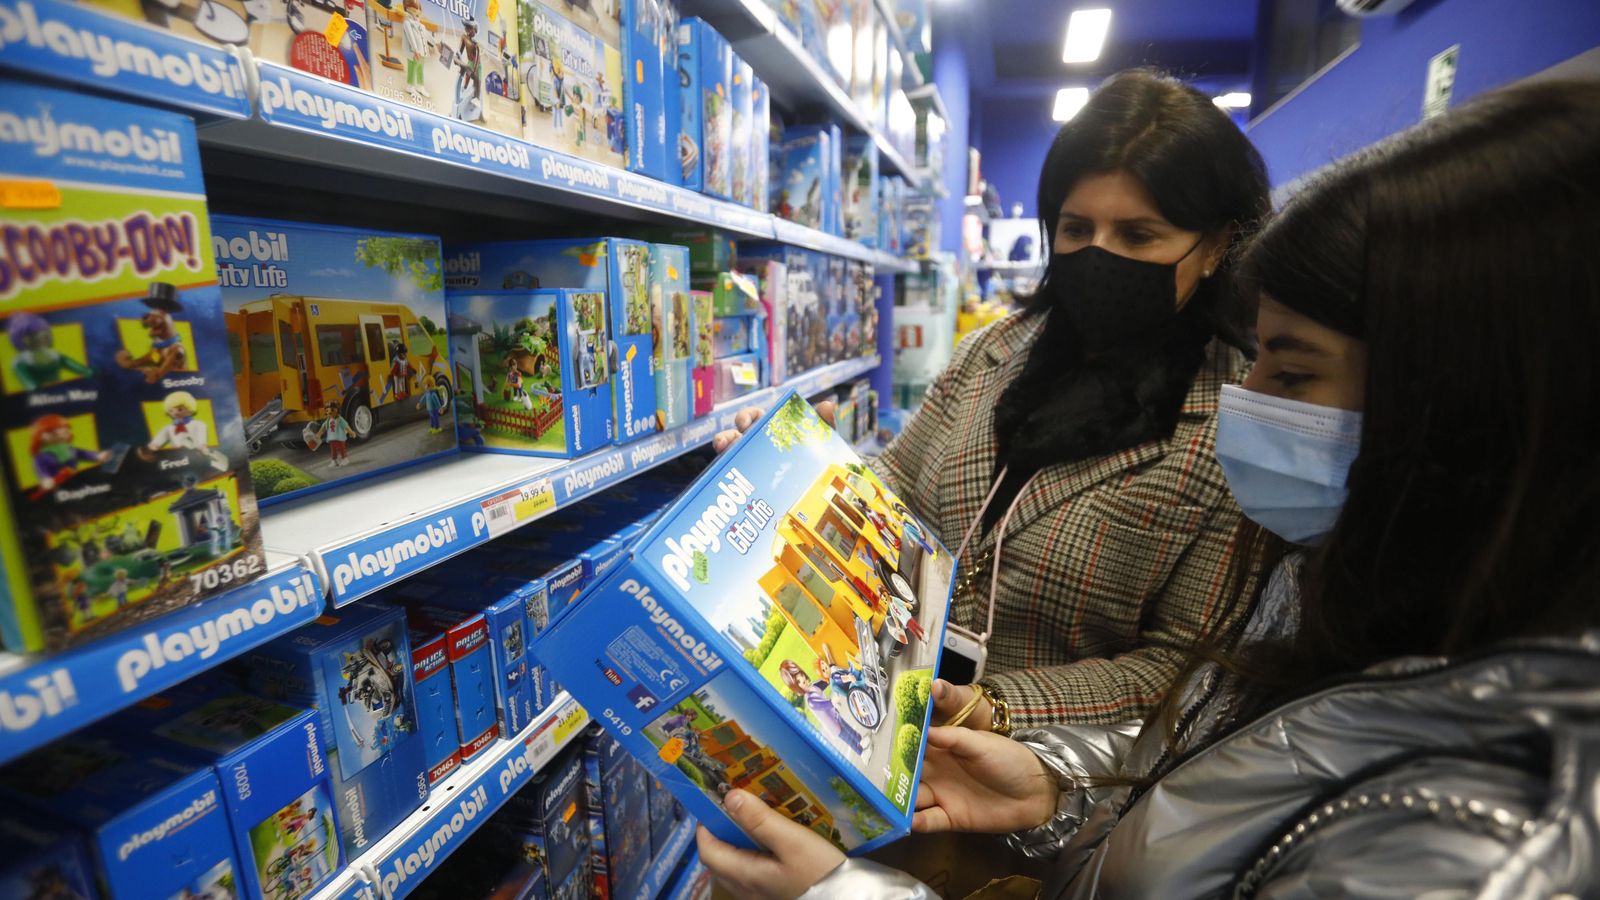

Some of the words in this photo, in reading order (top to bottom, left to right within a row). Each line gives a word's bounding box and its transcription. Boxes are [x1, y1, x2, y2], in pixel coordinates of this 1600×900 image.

[260, 76, 413, 142] playmobil
[0, 111, 183, 164] aymobil
[432, 125, 529, 170] playmobil
[541, 156, 609, 191] playmobil
[253, 263, 287, 288] Life
[162, 377, 205, 390] Scooby
[621, 360, 634, 437] playmobil
[572, 405, 582, 451] playmobil
[160, 456, 190, 470] Fred
[564, 453, 625, 498] playmobil
[662, 467, 756, 592] playmobil
[726, 519, 757, 556] City
[748, 497, 775, 531] Life
[190, 555, 261, 595] 70362
[333, 517, 457, 595] playmobil
[550, 565, 583, 594] playmobil
[117, 573, 315, 693] playmobil
[456, 628, 483, 649] POLICE
[619, 579, 723, 672] playmobil
[414, 648, 444, 671] POLICE
[473, 731, 492, 750] 70462
[602, 708, 632, 736] 9419
[303, 721, 325, 776] playmobil
[432, 758, 455, 778] 70462
[233, 762, 251, 801] 70093
[895, 772, 910, 807] 9419
[116, 789, 217, 862] playmobil
[345, 786, 369, 848] playmobil
[381, 785, 488, 900] playmobil
